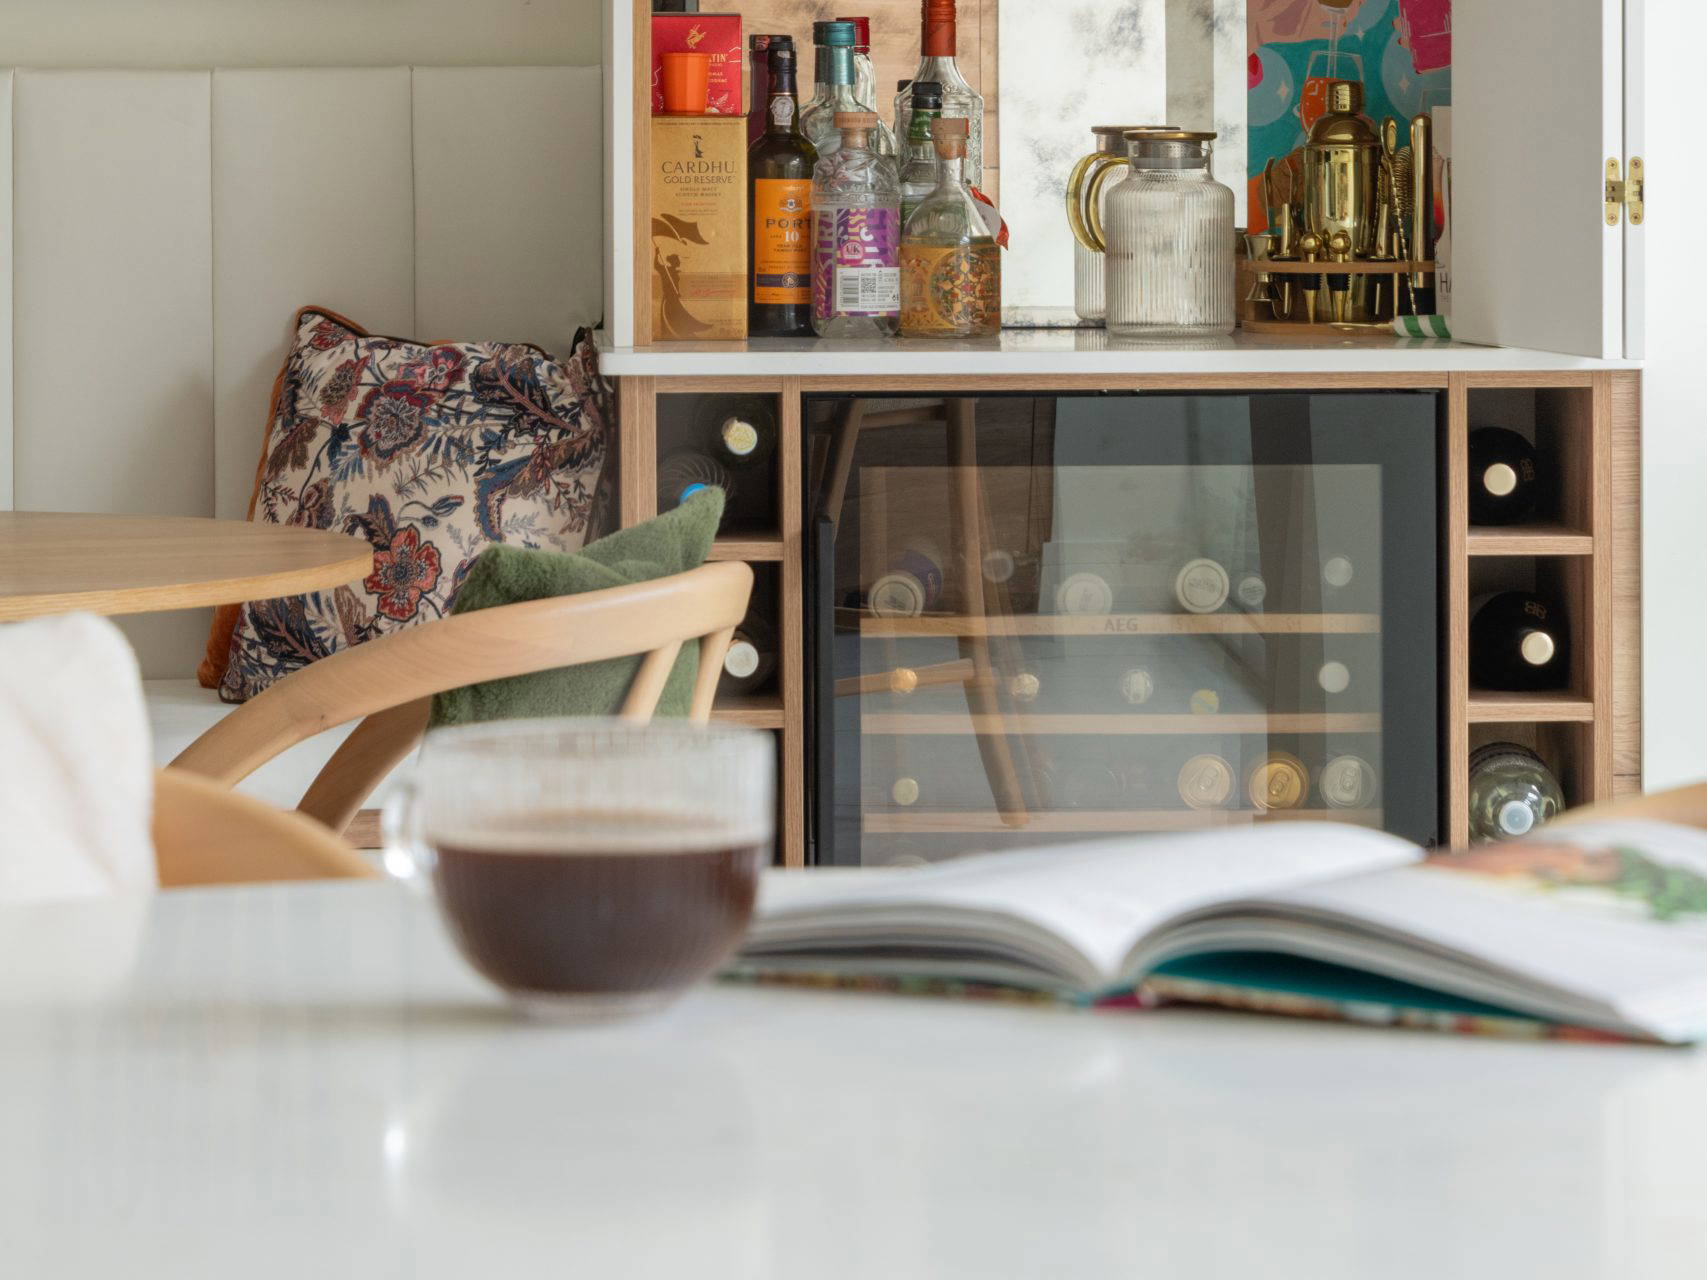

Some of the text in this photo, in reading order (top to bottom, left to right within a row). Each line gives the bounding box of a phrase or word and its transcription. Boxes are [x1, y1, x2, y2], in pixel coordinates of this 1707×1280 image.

[661, 160, 735, 174] CARDHU
[663, 175, 734, 184] GOLD RESERVE
[785, 231, 800, 242] 10
[1104, 618, 1138, 632] AEG
